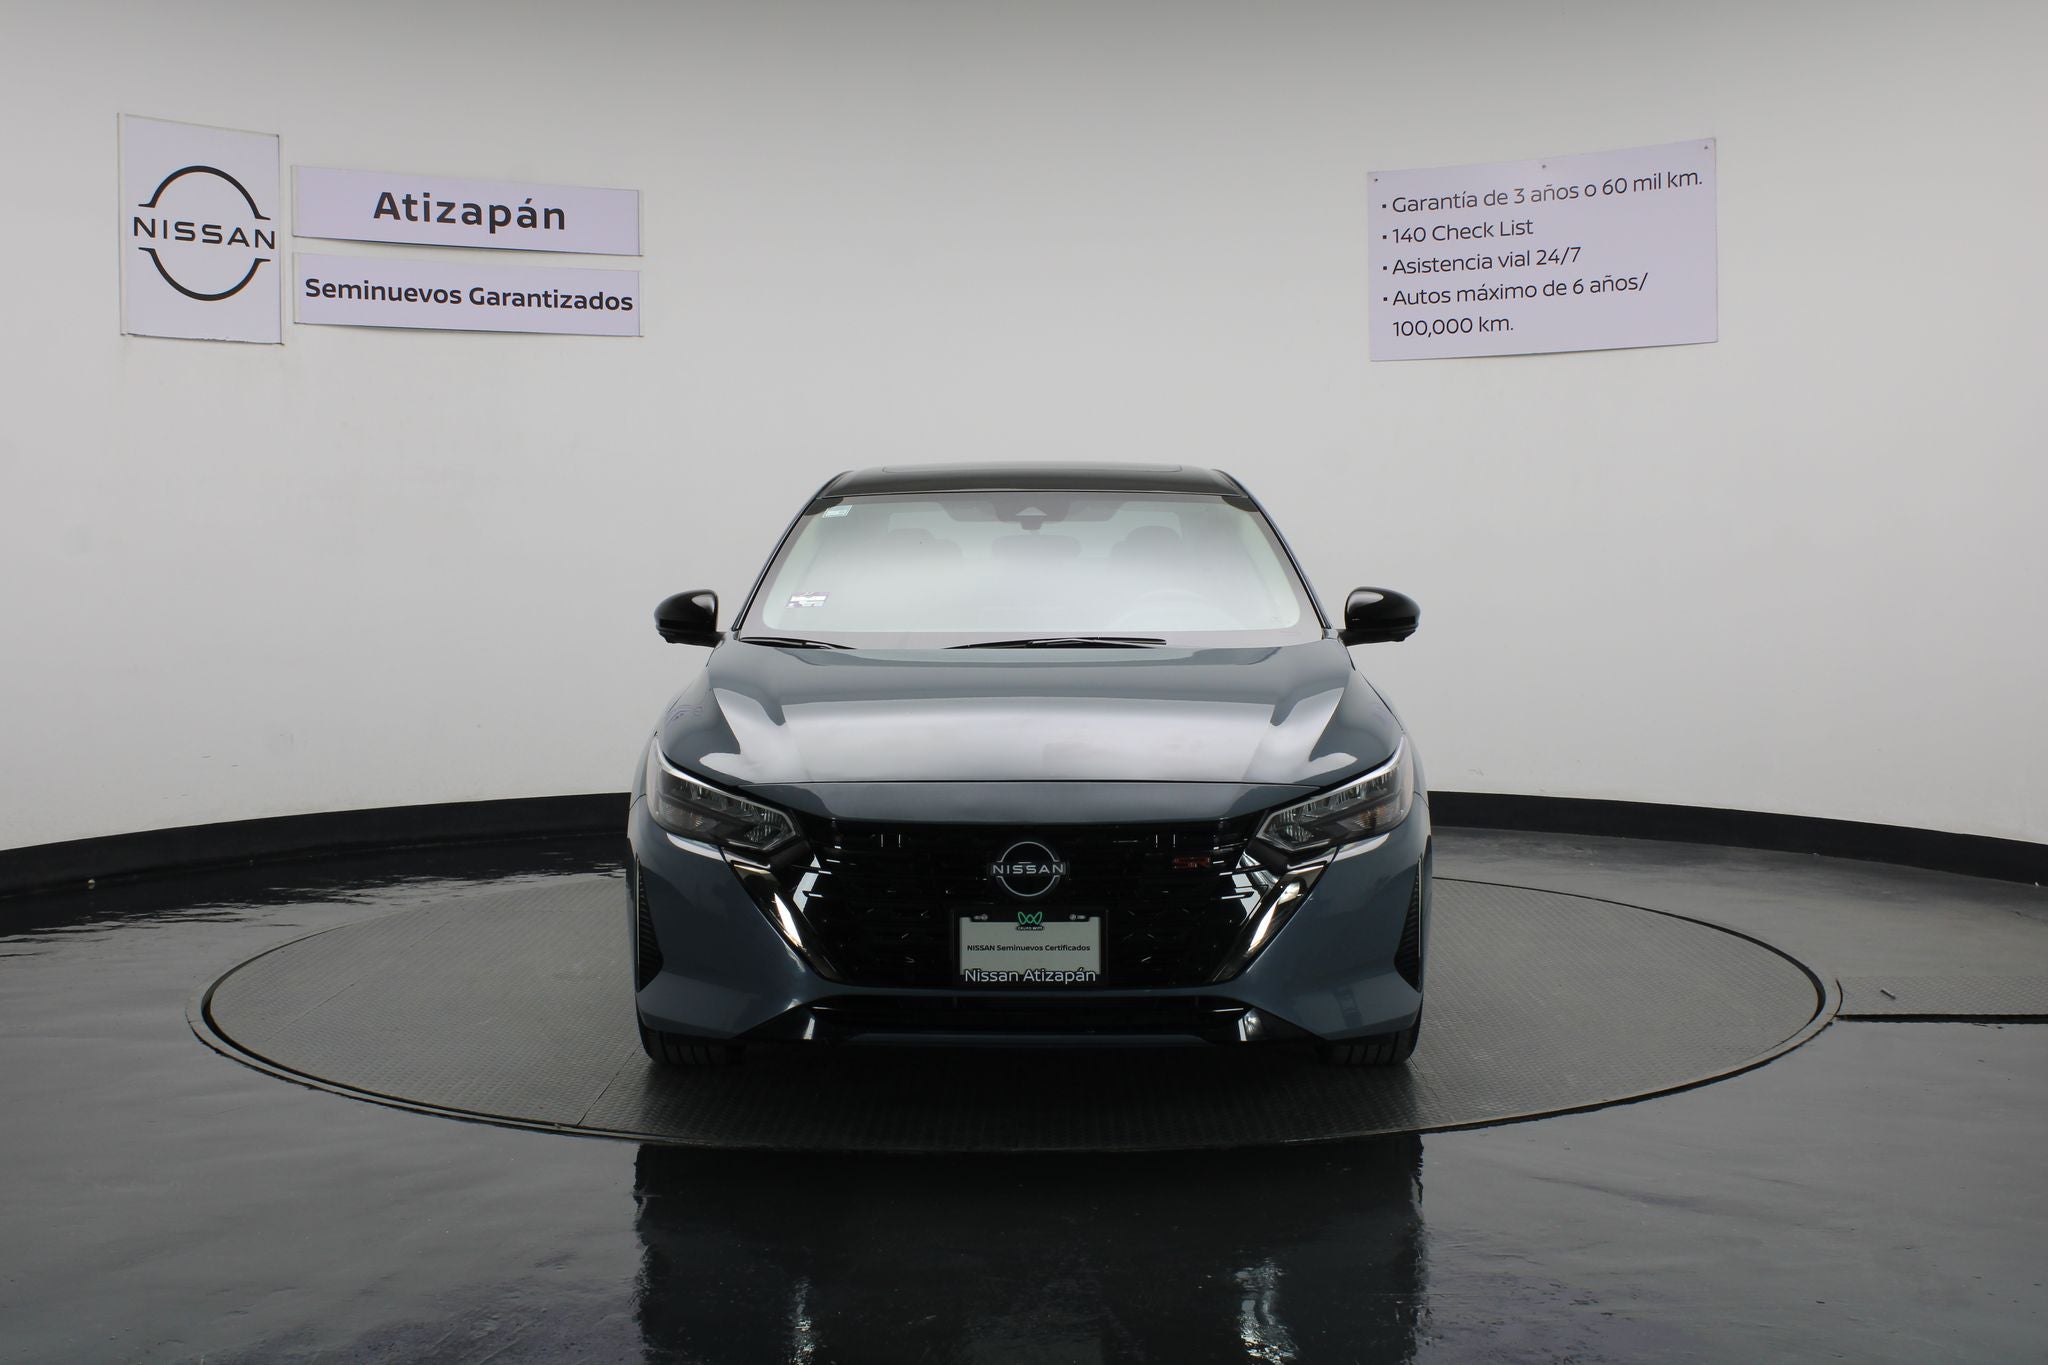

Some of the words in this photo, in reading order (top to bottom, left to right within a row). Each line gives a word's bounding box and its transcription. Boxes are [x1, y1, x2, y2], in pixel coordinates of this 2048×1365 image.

[1392, 190, 1477, 213] Garantía
[1483, 189, 1508, 206] de
[1513, 187, 1525, 204] 3
[1530, 184, 1579, 202] años
[1584, 183, 1597, 197] o
[1602, 177, 1628, 195] 60
[1633, 172, 1661, 192] mil
[1667, 170, 1703, 188] km.
[373, 191, 566, 234] Atizapán
[134, 216, 275, 249] NISSAN
[1392, 226, 1426, 243] 140
[1431, 221, 1494, 242] Check
[1500, 219, 1533, 237] List
[1392, 252, 1493, 275] Asistencia
[1498, 250, 1530, 268] vial
[1536, 246, 1582, 267] 24/7
[305, 277, 462, 305] Seminuevos
[469, 286, 633, 312] Garantizados
[1392, 287, 1451, 306] Autos
[1457, 281, 1537, 302] máximo
[1542, 280, 1567, 297] de
[1572, 278, 1584, 295] 6
[1590, 272, 1648, 293] años/
[1392, 317, 1473, 337] 100,000
[1478, 315, 1514, 333] km.
[992, 864, 1065, 875] NISSAN
[967, 944, 995, 952] NISSAN
[997, 944, 1043, 952] Seminuevos
[1045, 943, 1091, 952] Certificados
[965, 968, 1018, 982] Nissan
[1023, 967, 1096, 984] Atizapán
